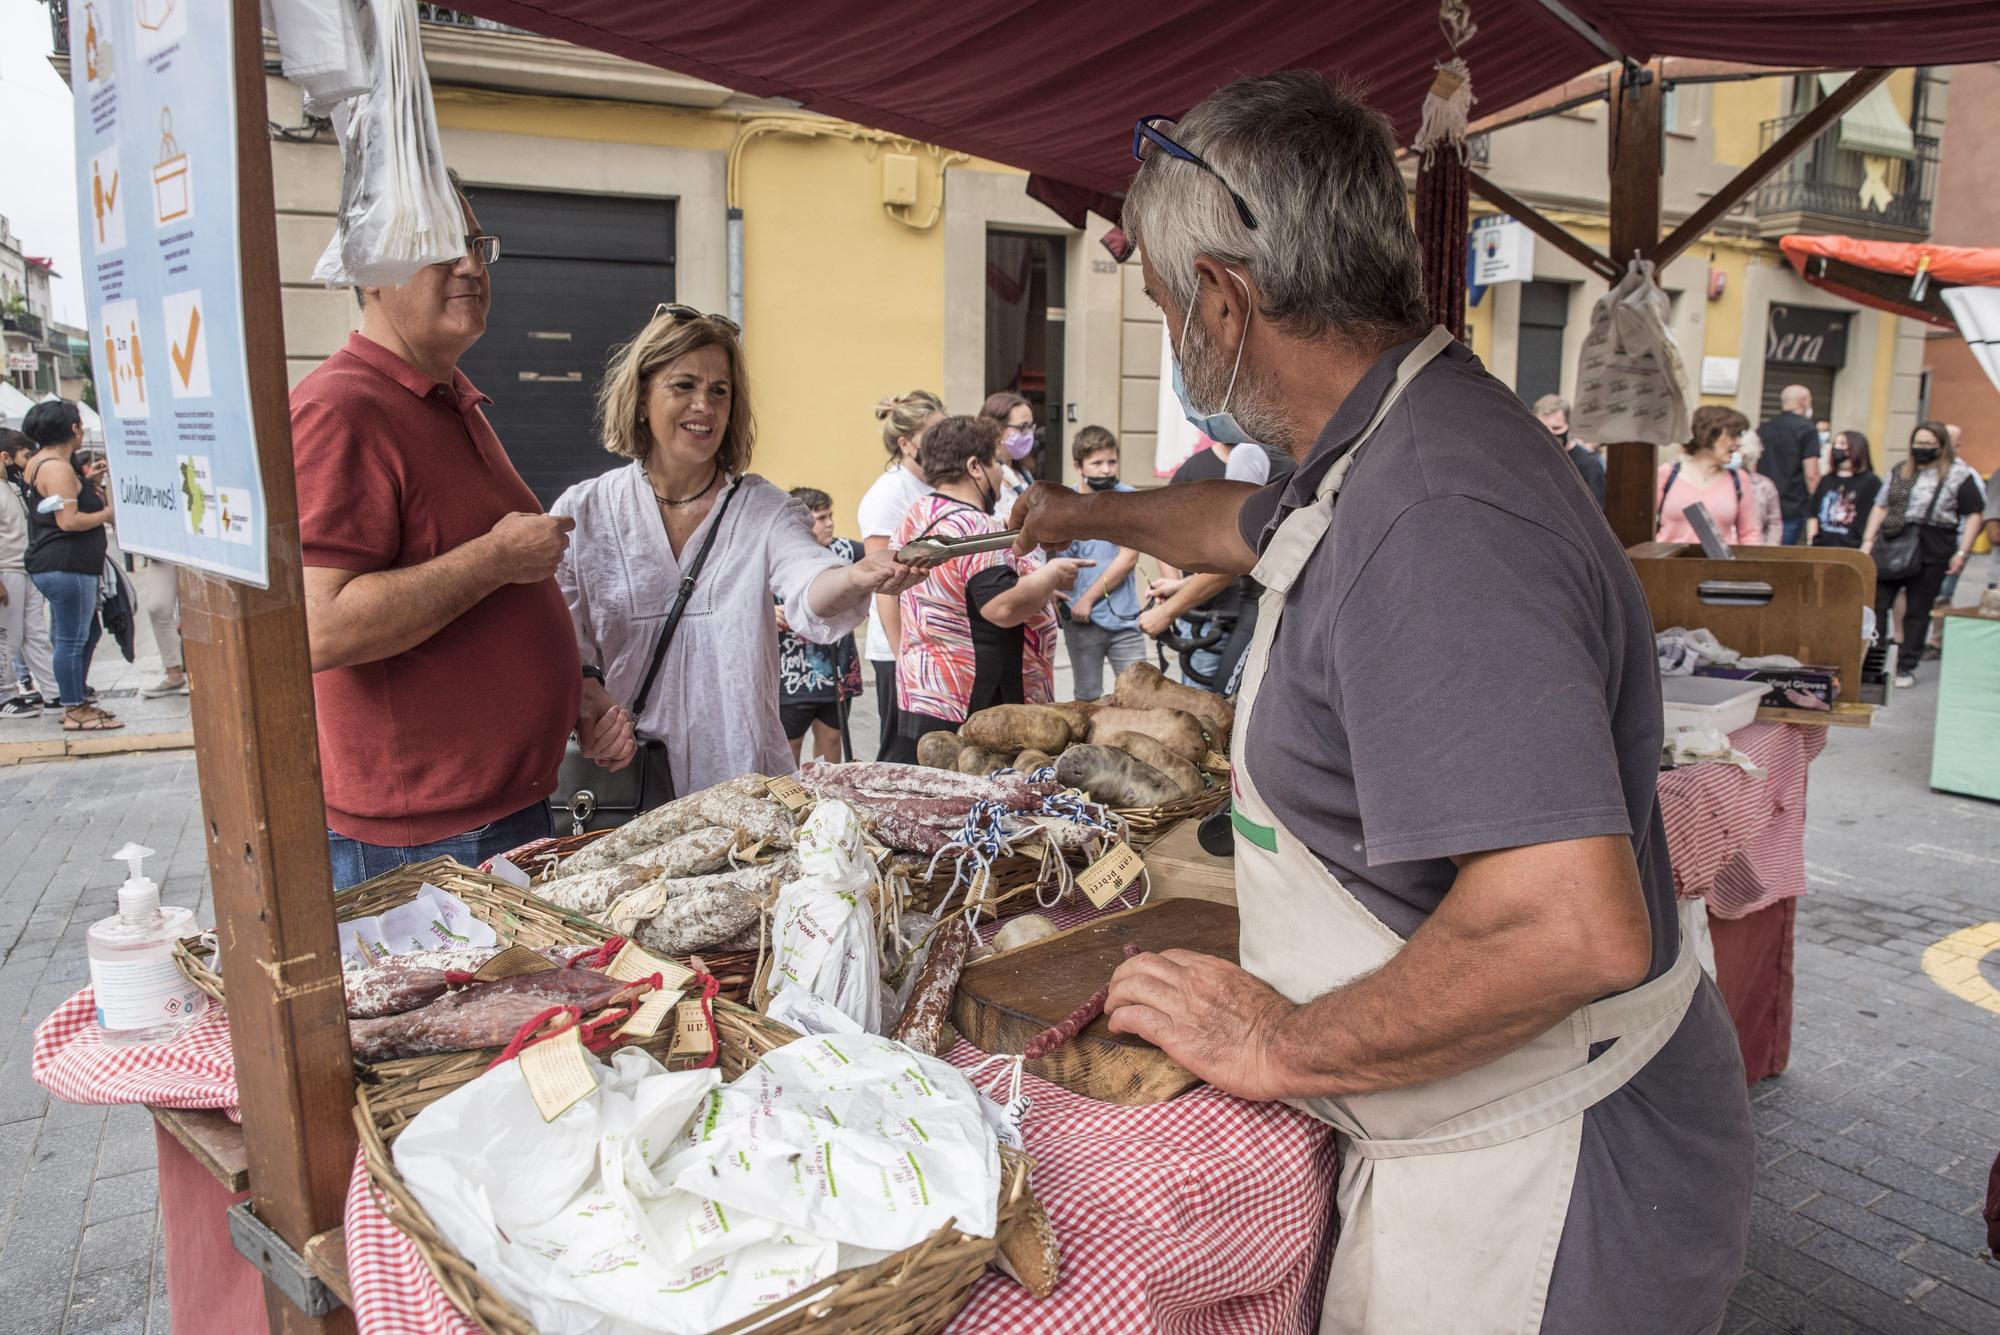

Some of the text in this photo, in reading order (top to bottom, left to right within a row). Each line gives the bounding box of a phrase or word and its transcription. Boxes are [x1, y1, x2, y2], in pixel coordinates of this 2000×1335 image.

[1766, 306, 1824, 362] Sera
[120, 472, 177, 511] Cuidem-nos!
[1767, 679, 1828, 690] Vinyl Gloves
[819, 928, 828, 937] de
